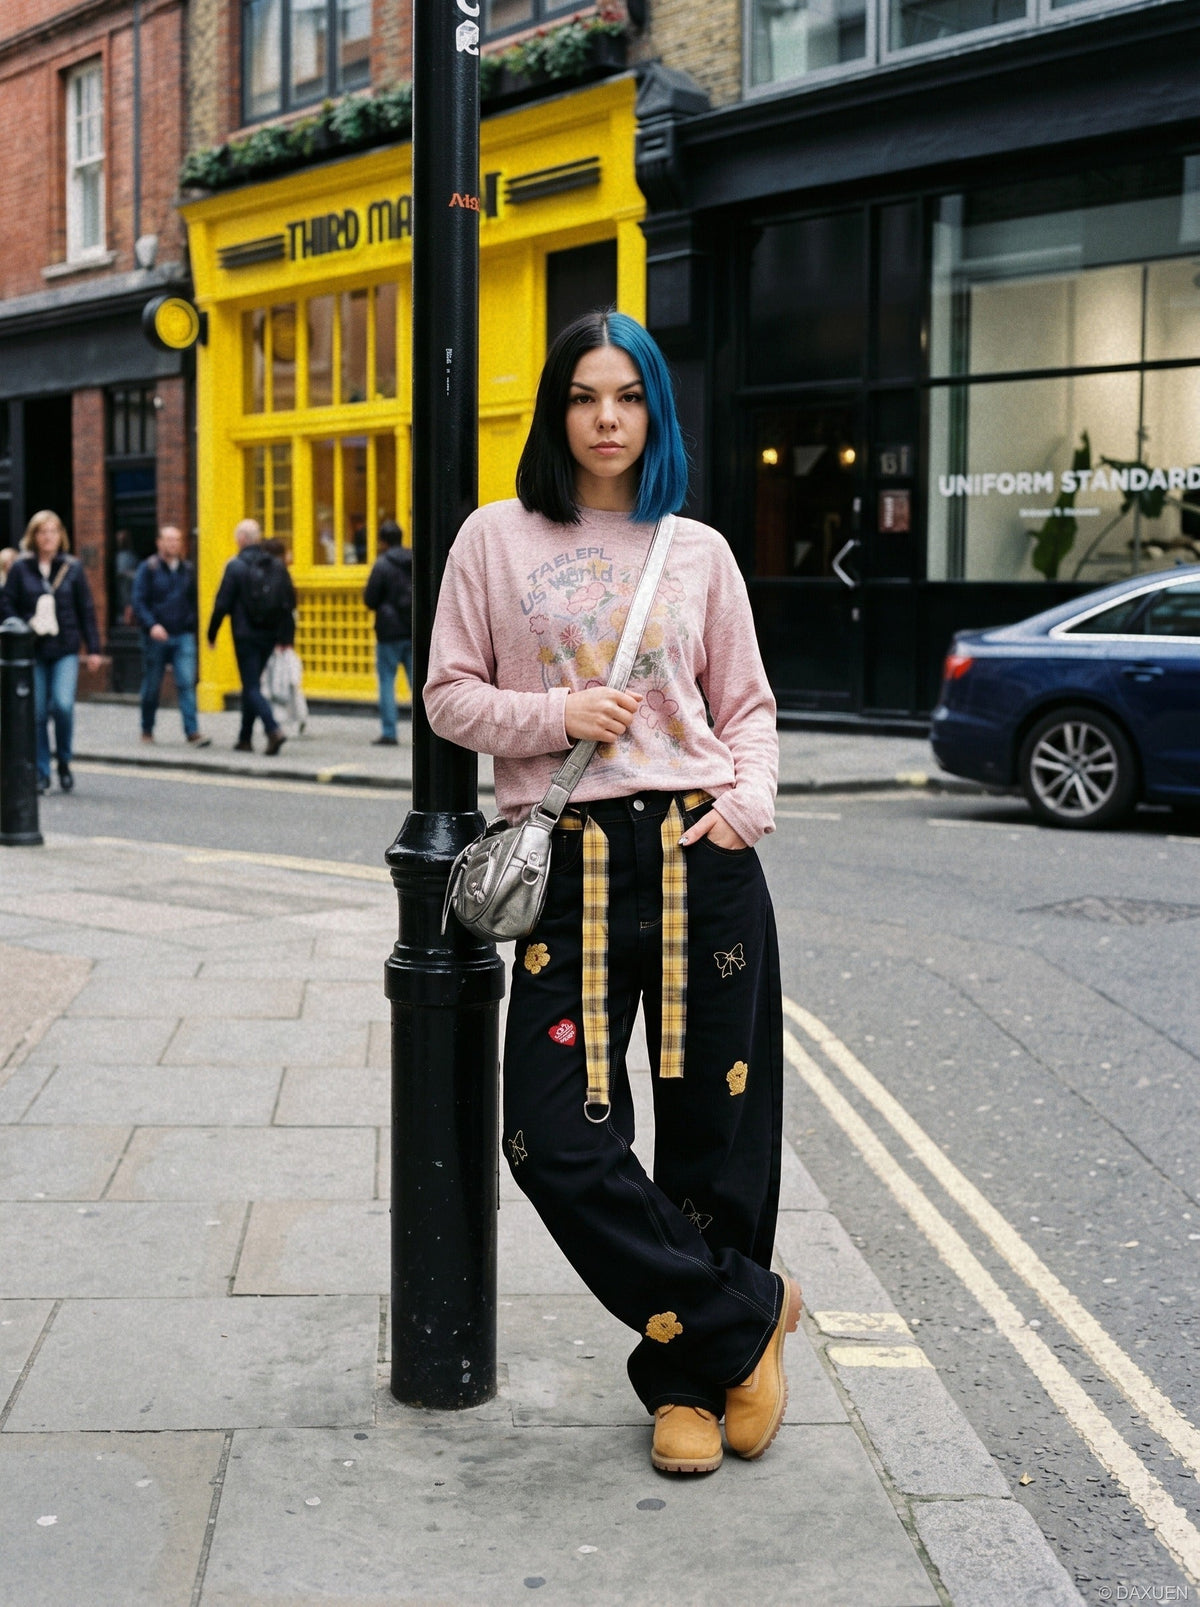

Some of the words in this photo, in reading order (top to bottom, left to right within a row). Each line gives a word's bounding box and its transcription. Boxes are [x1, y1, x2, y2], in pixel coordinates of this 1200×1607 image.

[287, 209, 360, 261] THIRD
[938, 471, 1055, 497] UNIFORM
[1061, 467, 1200, 494] STANDARD
[520, 584, 547, 616] US
